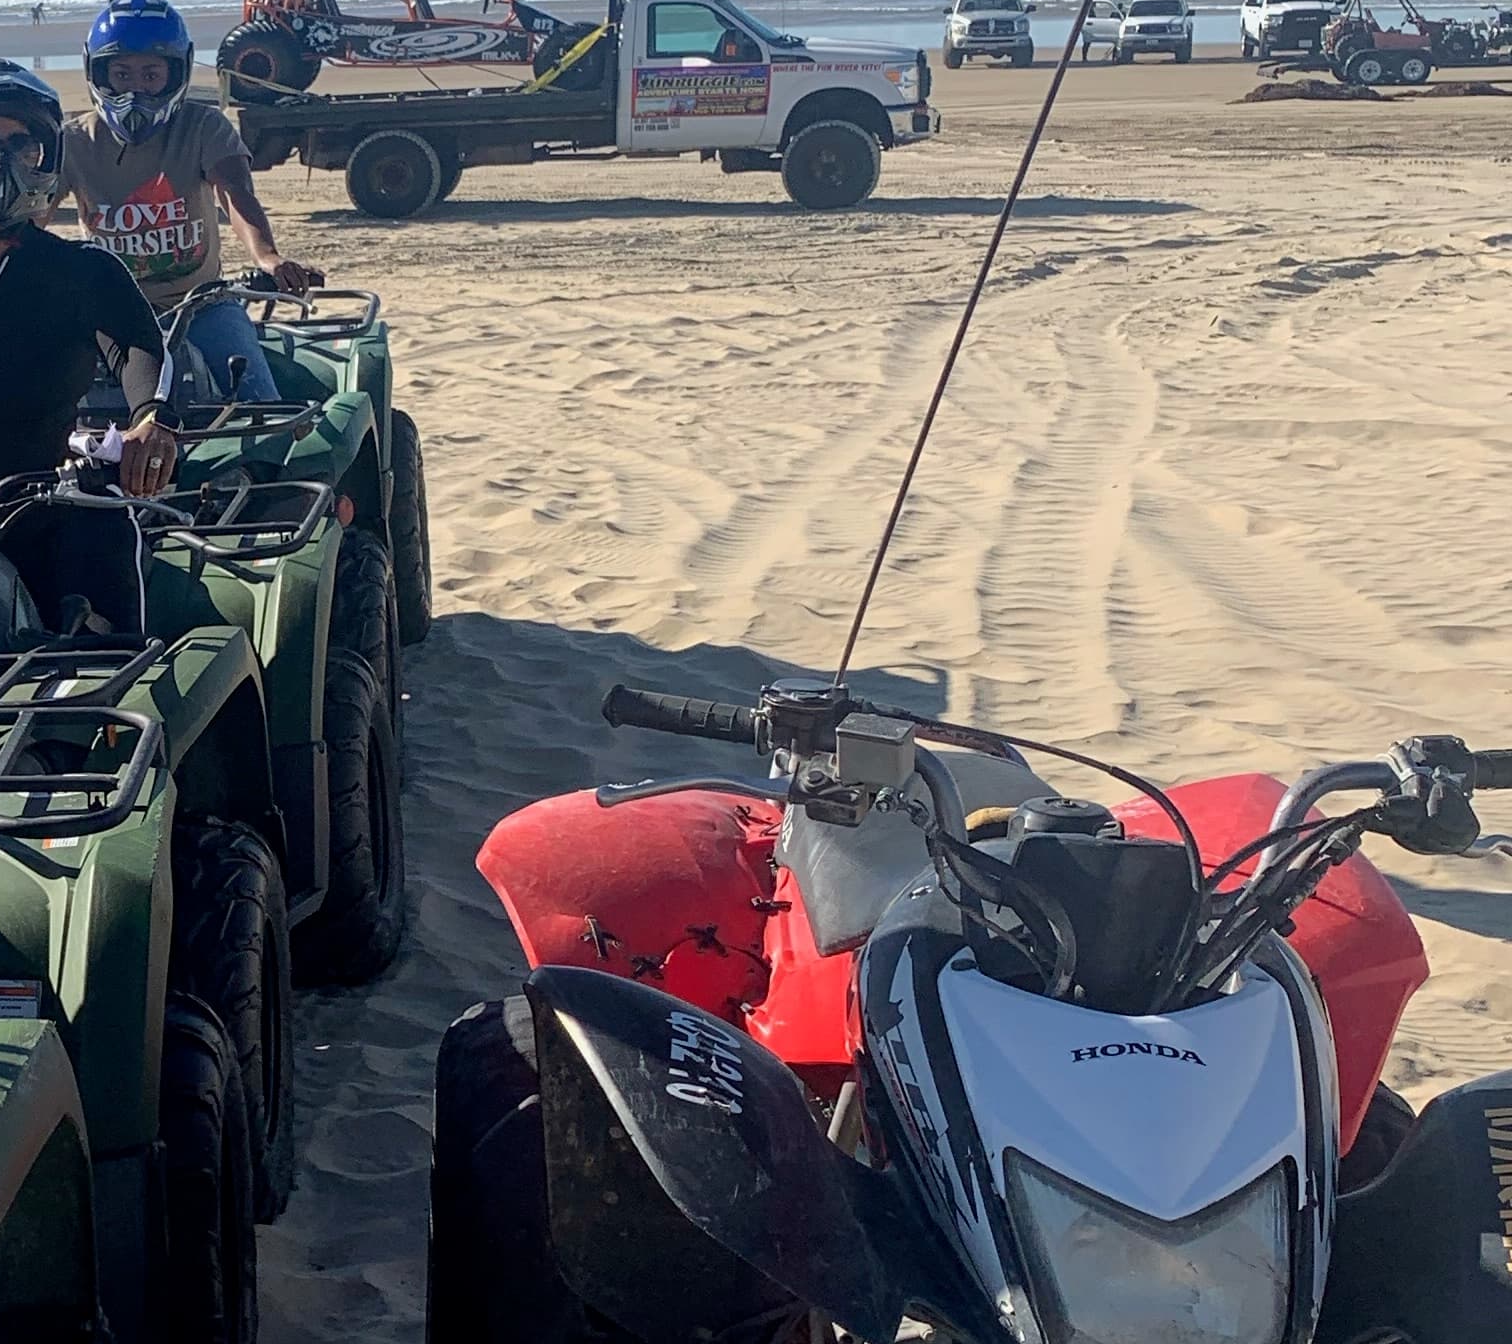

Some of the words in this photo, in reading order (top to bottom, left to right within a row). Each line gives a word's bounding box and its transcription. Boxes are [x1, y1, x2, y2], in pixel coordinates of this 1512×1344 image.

[96, 197, 188, 232] LOVE
[90, 218, 205, 256] OURSELF
[1070, 1042, 1207, 1067] HONDA
